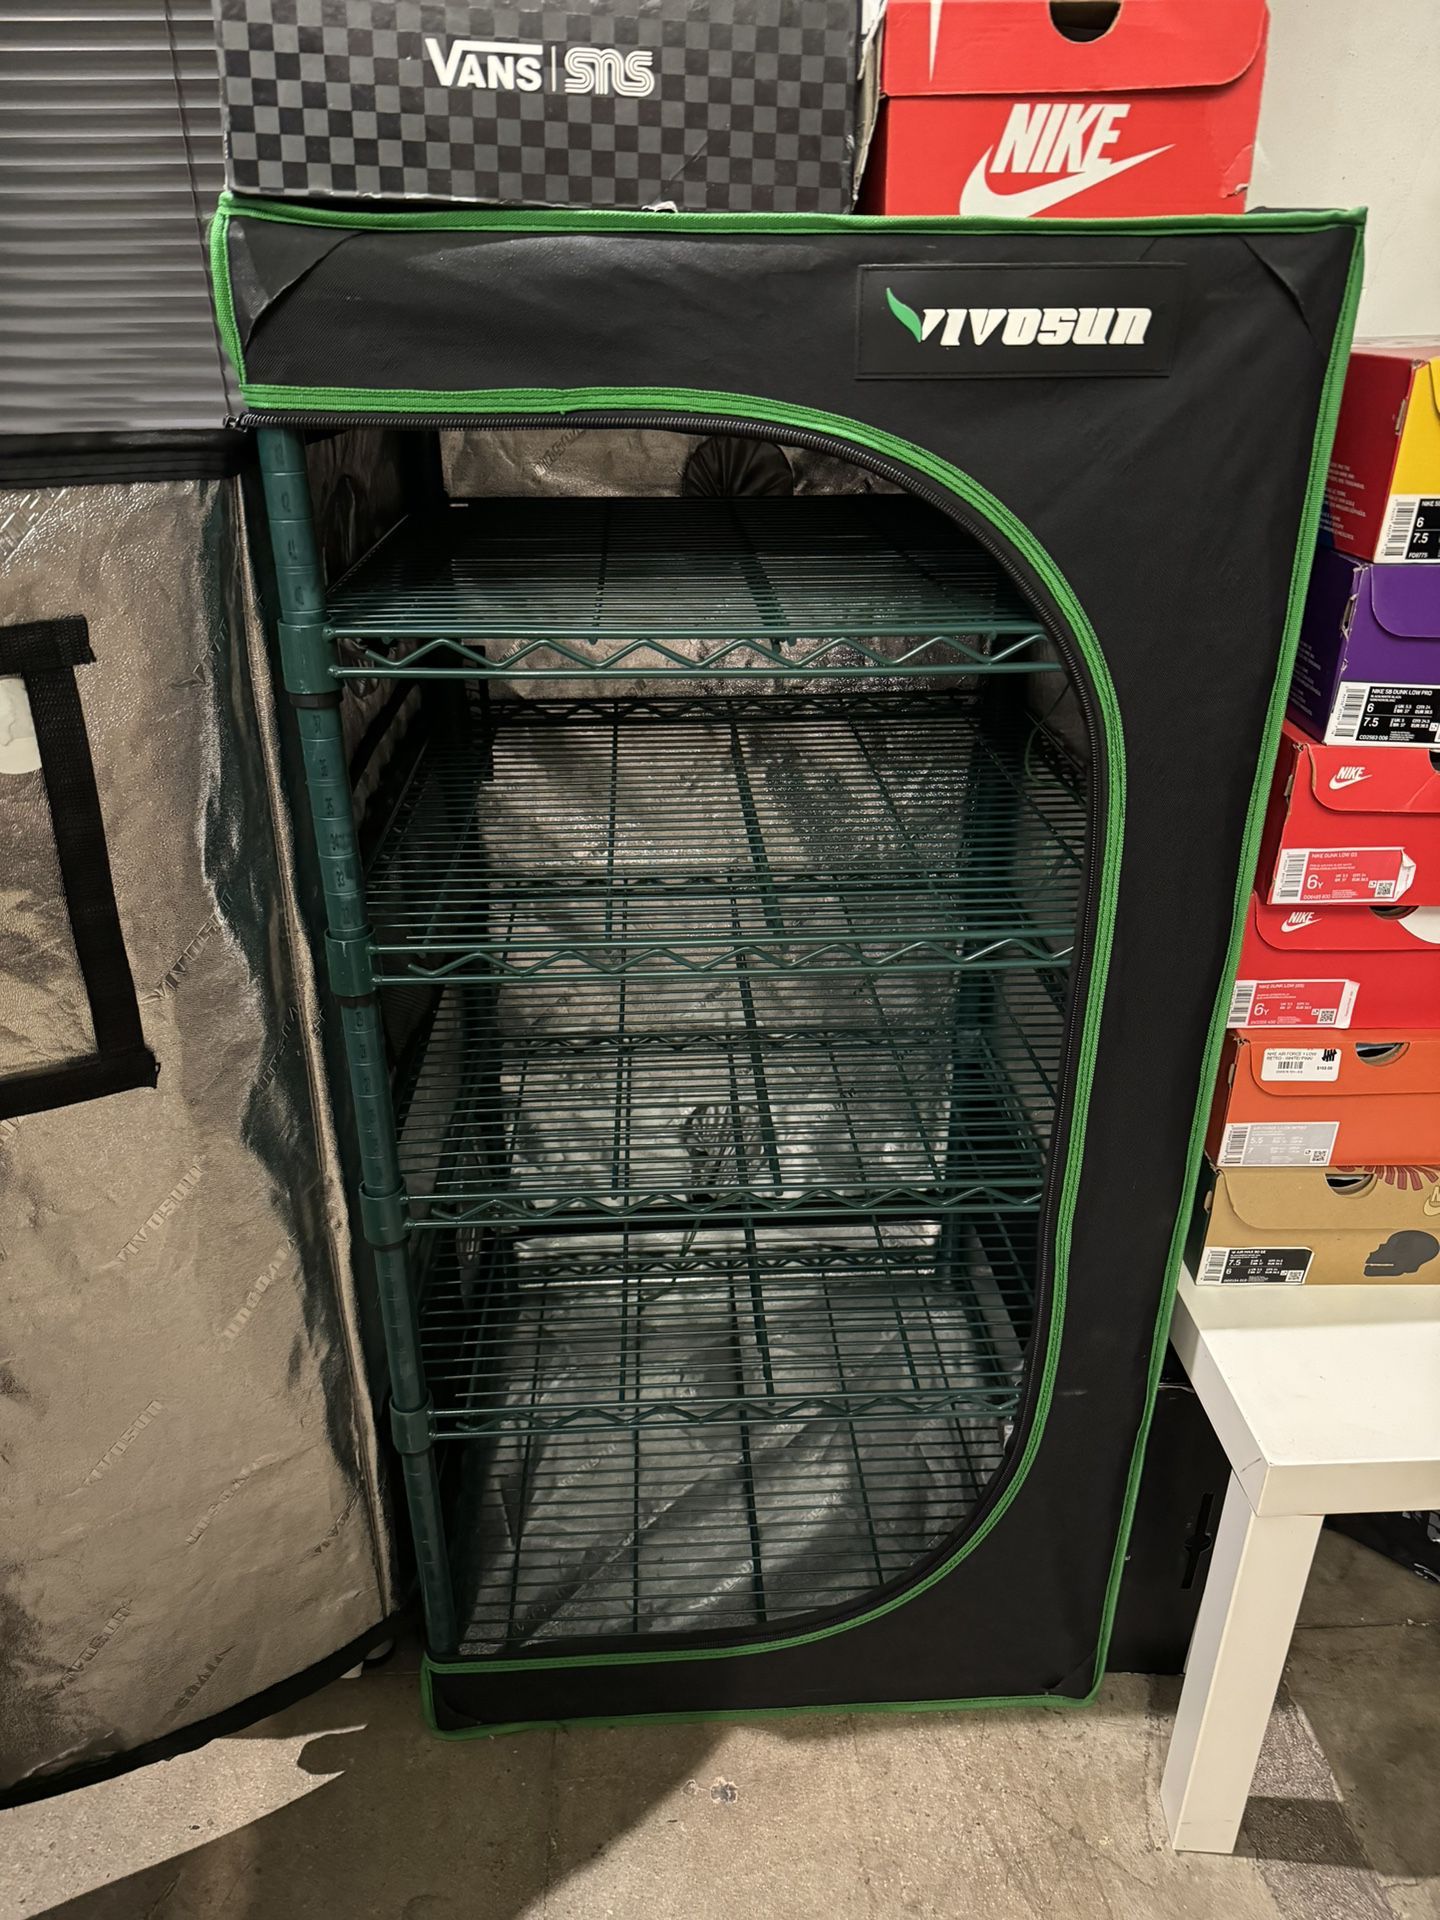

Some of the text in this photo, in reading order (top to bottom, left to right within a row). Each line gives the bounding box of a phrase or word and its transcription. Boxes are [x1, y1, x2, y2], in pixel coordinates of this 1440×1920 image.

[425, 38, 543, 91] VANS
[990, 103, 1131, 174] NIKE
[920, 307, 1153, 347] VIVOSUN
[1416, 517, 1424, 528] 6
[1413, 533, 1429, 544] 7.5
[1366, 703, 1375, 713] 6
[1363, 717, 1379, 727] 7.5
[1336, 766, 1366, 780] NIKE
[1288, 911, 1316, 924] NIKE
[114, 1162, 206, 1263] VIVOSUN
